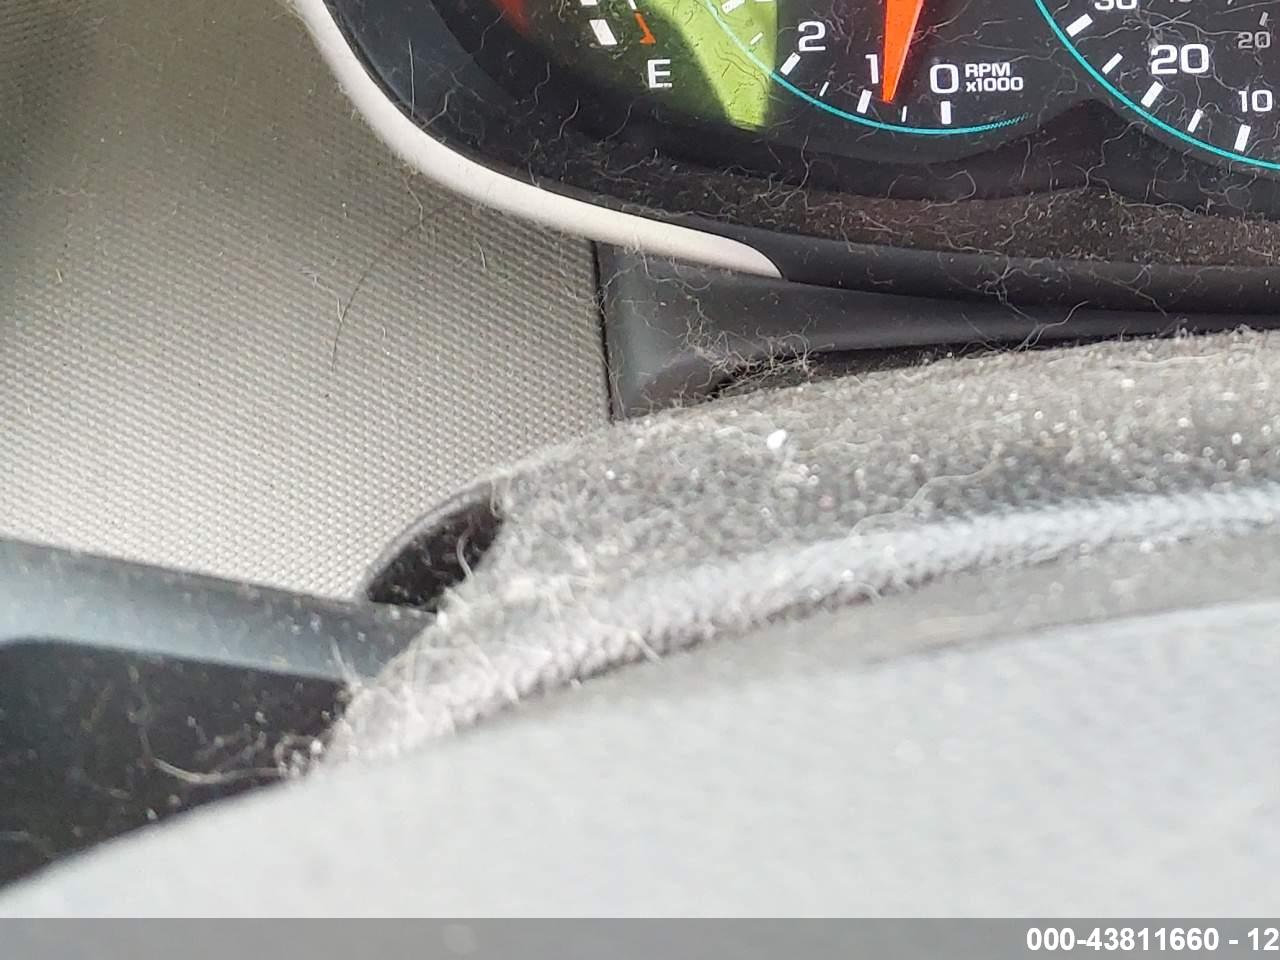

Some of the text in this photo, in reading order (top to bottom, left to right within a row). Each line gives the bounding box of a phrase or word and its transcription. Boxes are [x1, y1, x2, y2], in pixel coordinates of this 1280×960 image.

[797, 20, 826, 51] 2
[1238, 31, 1271, 49] 20
[647, 59, 672, 89] E
[866, 54, 880, 83] 1
[965, 63, 1011, 77] RPM
[1151, 44, 1209, 75] 20
[930, 65, 959, 94] 0
[965, 75, 1024, 92] x1000
[1239, 90, 1273, 113] 10
